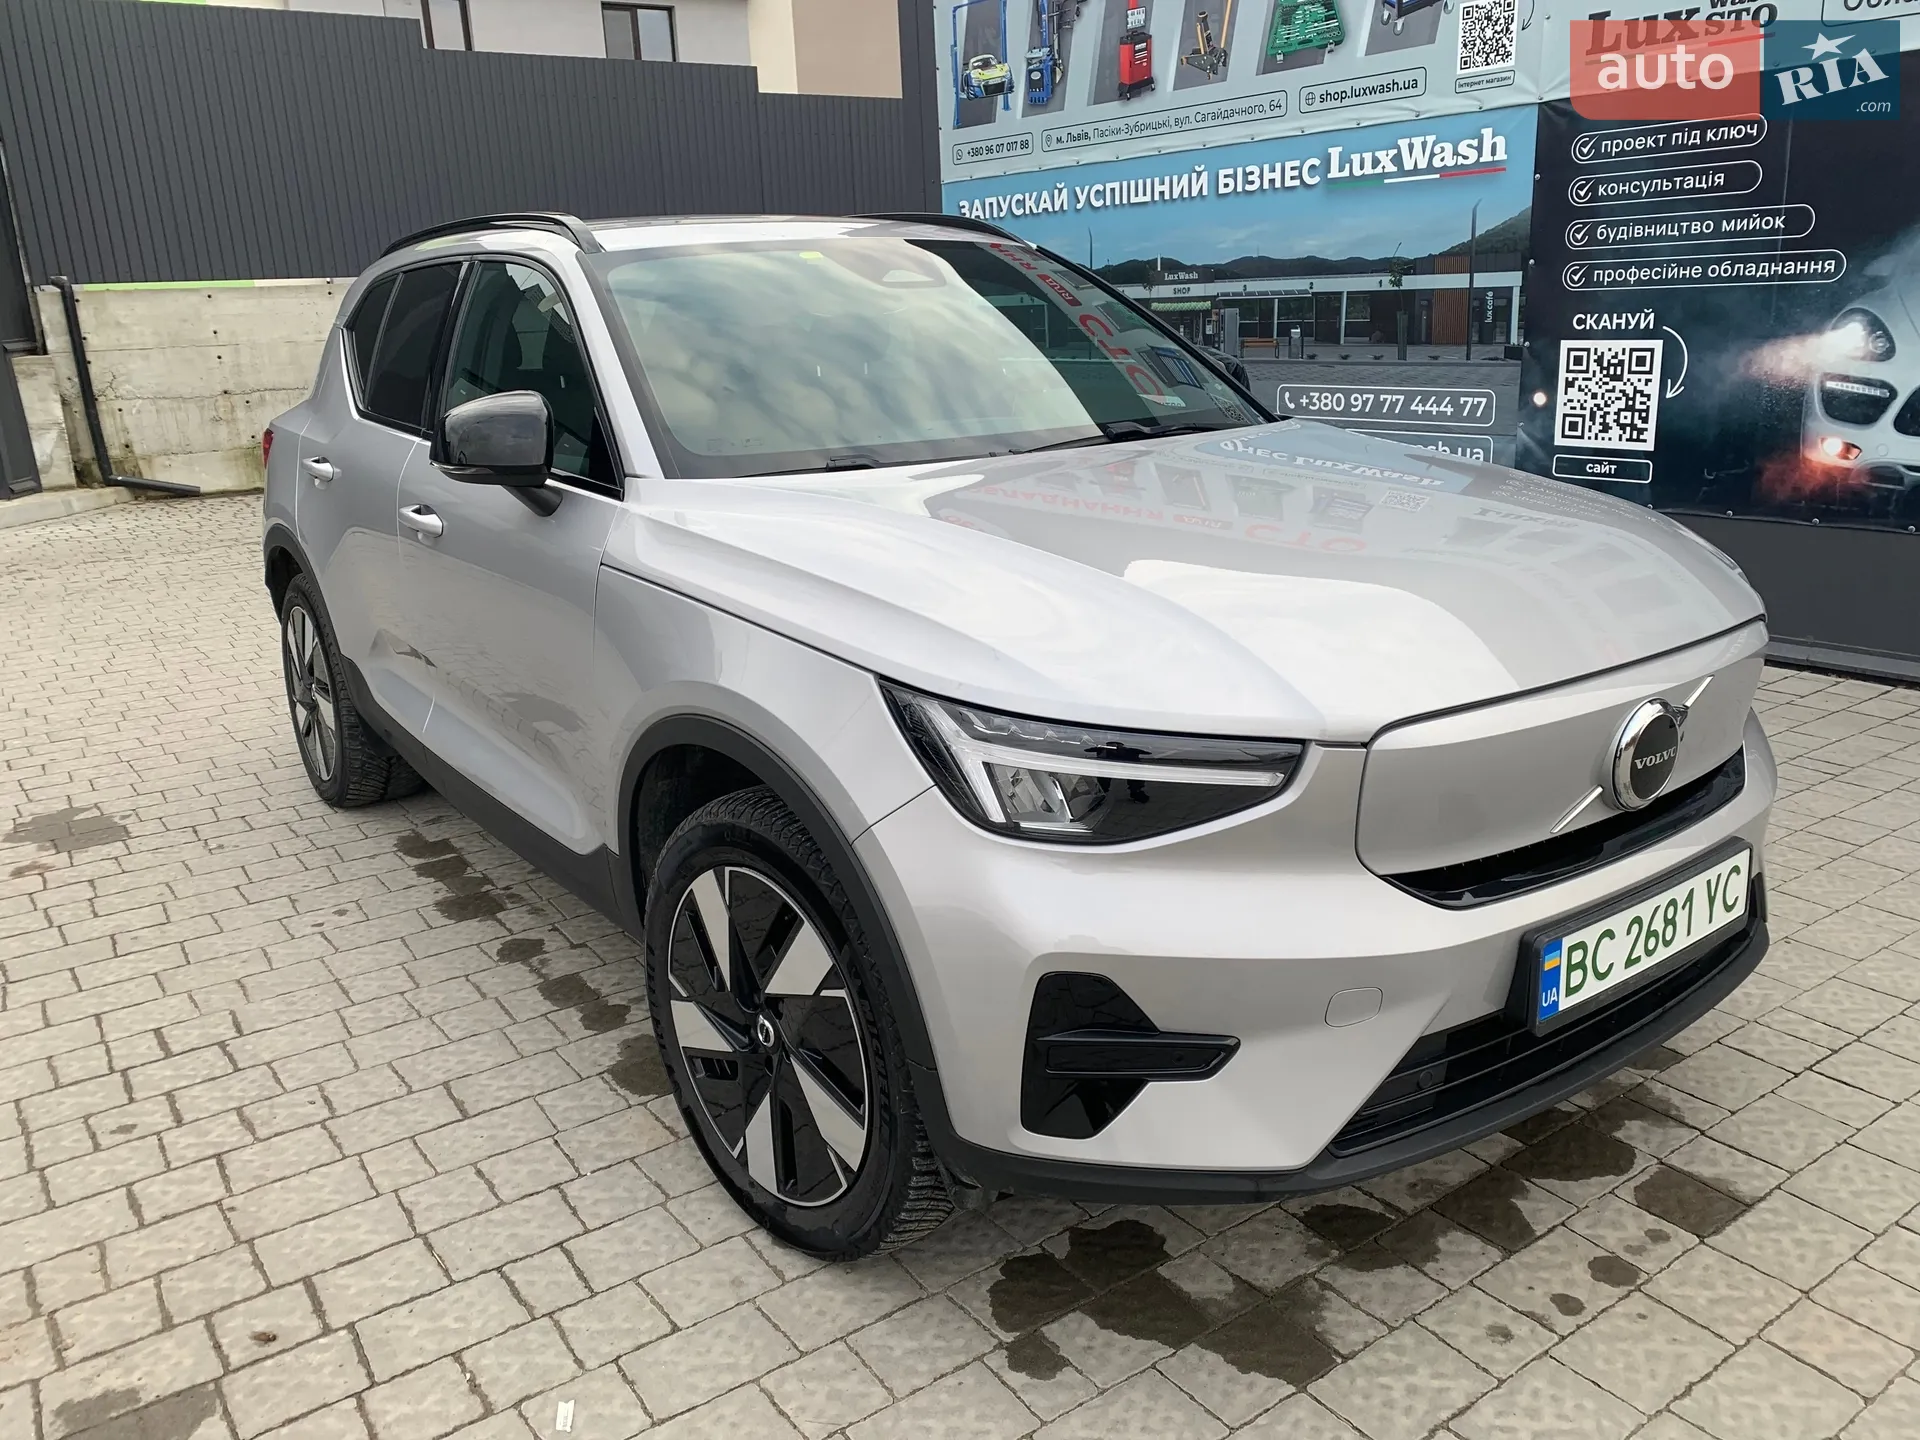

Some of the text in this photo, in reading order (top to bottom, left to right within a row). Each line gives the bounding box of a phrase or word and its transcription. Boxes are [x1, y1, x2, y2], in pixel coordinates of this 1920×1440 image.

[1586, 7, 1700, 56] Lux
[1319, 78, 1418, 103] shop.luxwash.ua
[1458, 75, 1511, 89] інтернет магазин
[1056, 99, 1282, 145] м. Львів, Пасіки-Зубрицькі, вул. Сагайдачного, 64
[967, 139, 1029, 158] +380 96 07 017 88
[1601, 123, 1759, 156] проект під ключ
[959, 127, 1507, 220] ЗАПУСКАЙ УСПІШНИЙ БІЗНЕС LuxWash
[1598, 171, 1725, 197] консультація
[1596, 213, 1786, 242] будівництво мийок
[1164, 271, 1198, 280] LuxWash
[1593, 258, 1836, 284] професійне обладнання
[1572, 308, 1655, 331] СКАНУЙ
[1300, 391, 1487, 417] +380 97 77 444 77
[1586, 461, 1617, 475] сайт
[1624, 888, 1694, 969] 2681
[1706, 865, 1741, 924] YC
[1542, 989, 1558, 1007] UA
